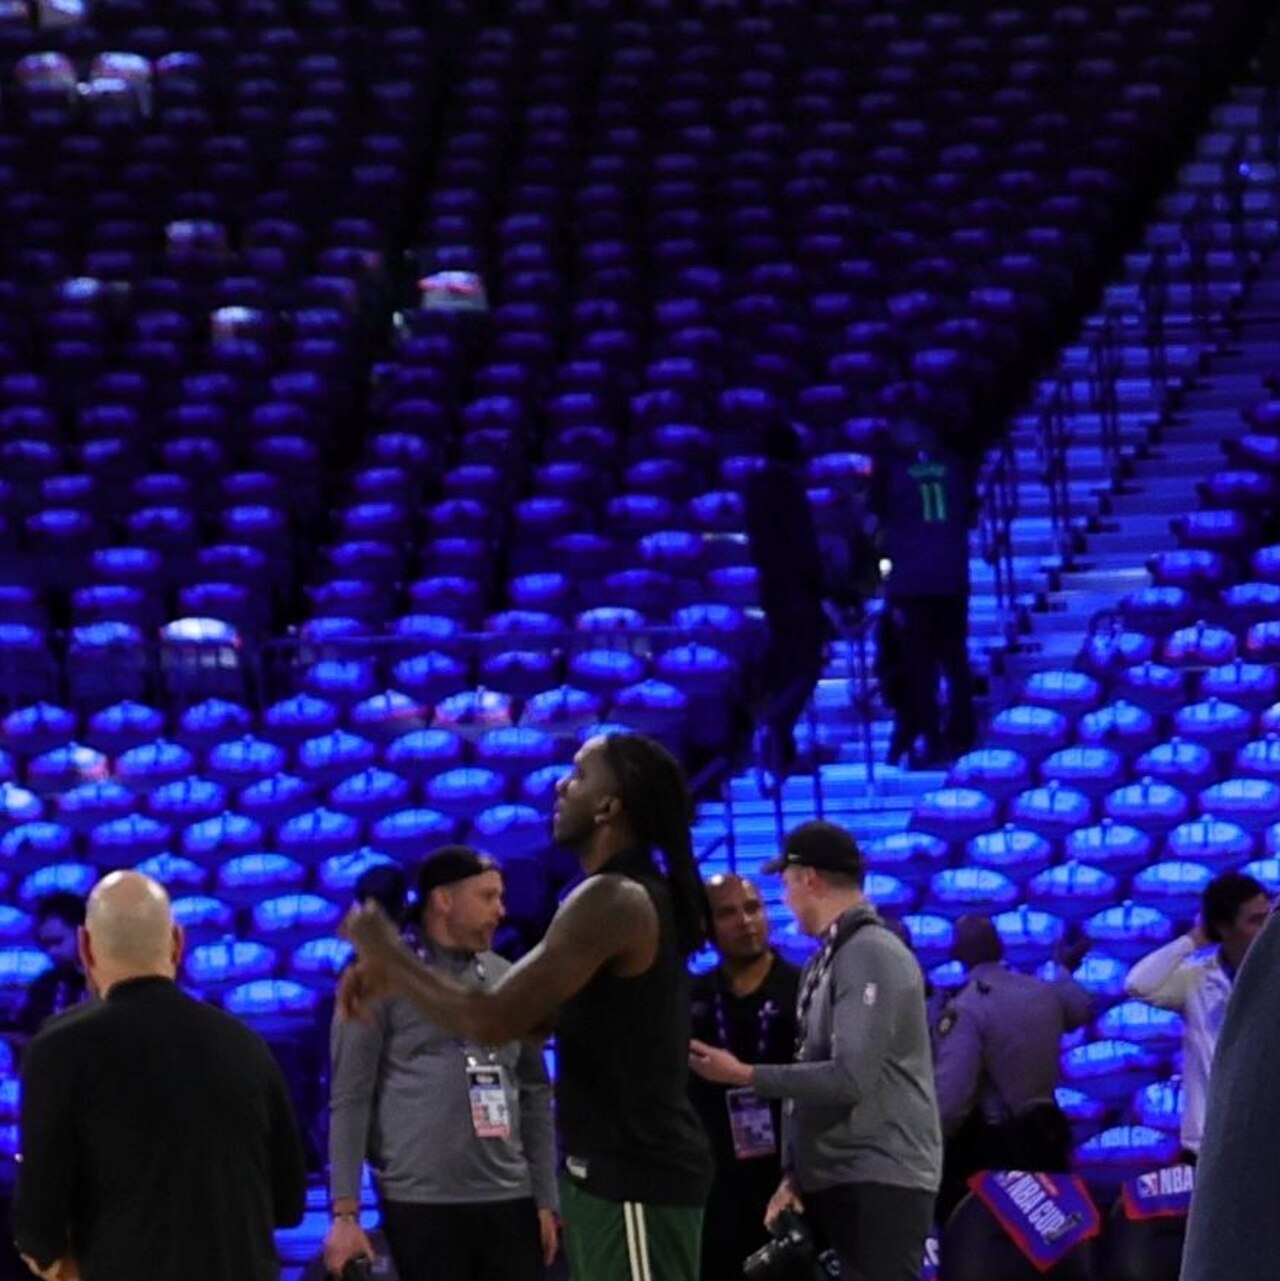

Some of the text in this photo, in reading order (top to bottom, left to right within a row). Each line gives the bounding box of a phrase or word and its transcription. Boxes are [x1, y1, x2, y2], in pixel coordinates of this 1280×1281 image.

[1160, 1164, 1193, 1196] NBA
[1005, 1173, 1046, 1215] NBA
[1028, 1200, 1065, 1236] CUP
